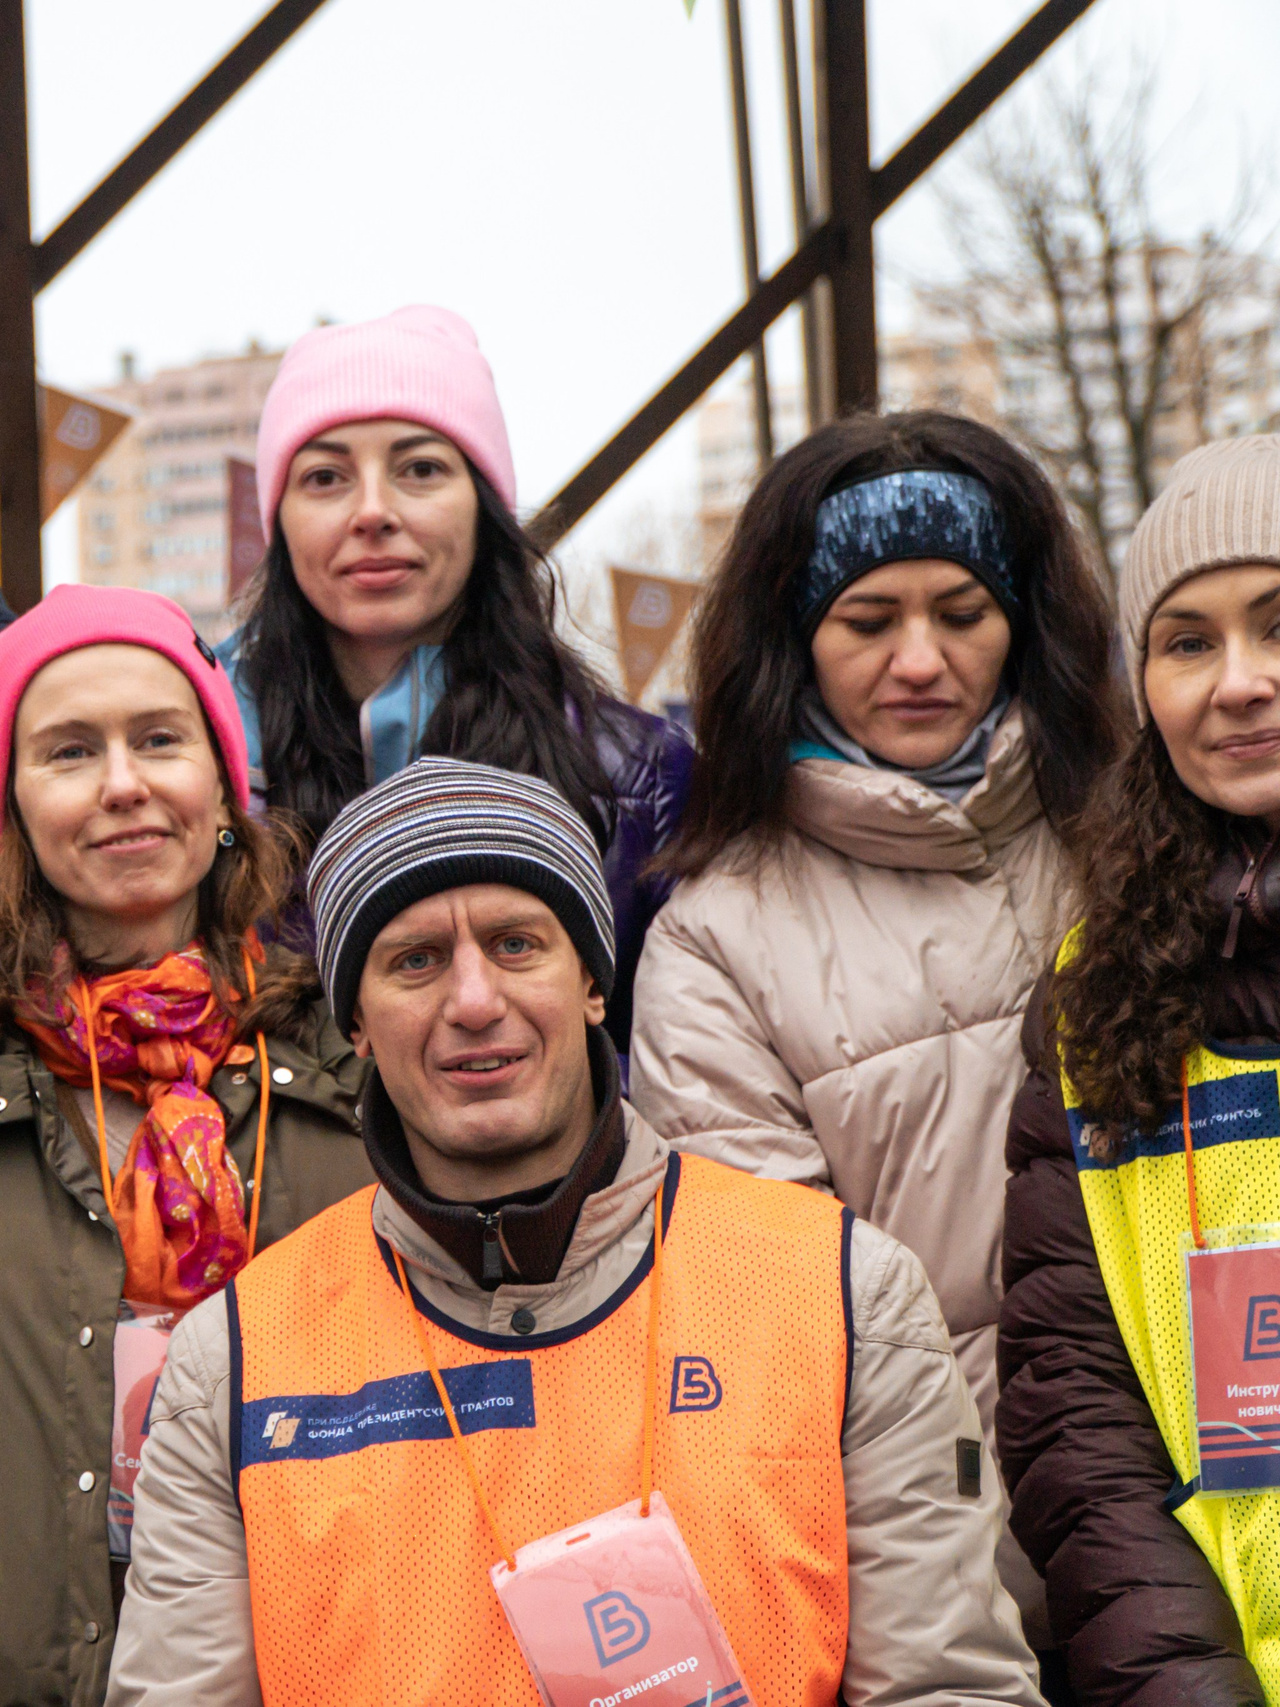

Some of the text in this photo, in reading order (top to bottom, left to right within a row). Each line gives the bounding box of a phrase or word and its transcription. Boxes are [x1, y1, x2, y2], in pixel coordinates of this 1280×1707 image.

[1227, 1384, 1280, 1398] Инстру
[308, 1425, 353, 1439] ФОНДА
[460, 1396, 514, 1413] ГРАНТОВ
[1238, 1405, 1280, 1417] нович
[589, 1656, 699, 1707] Организатор
